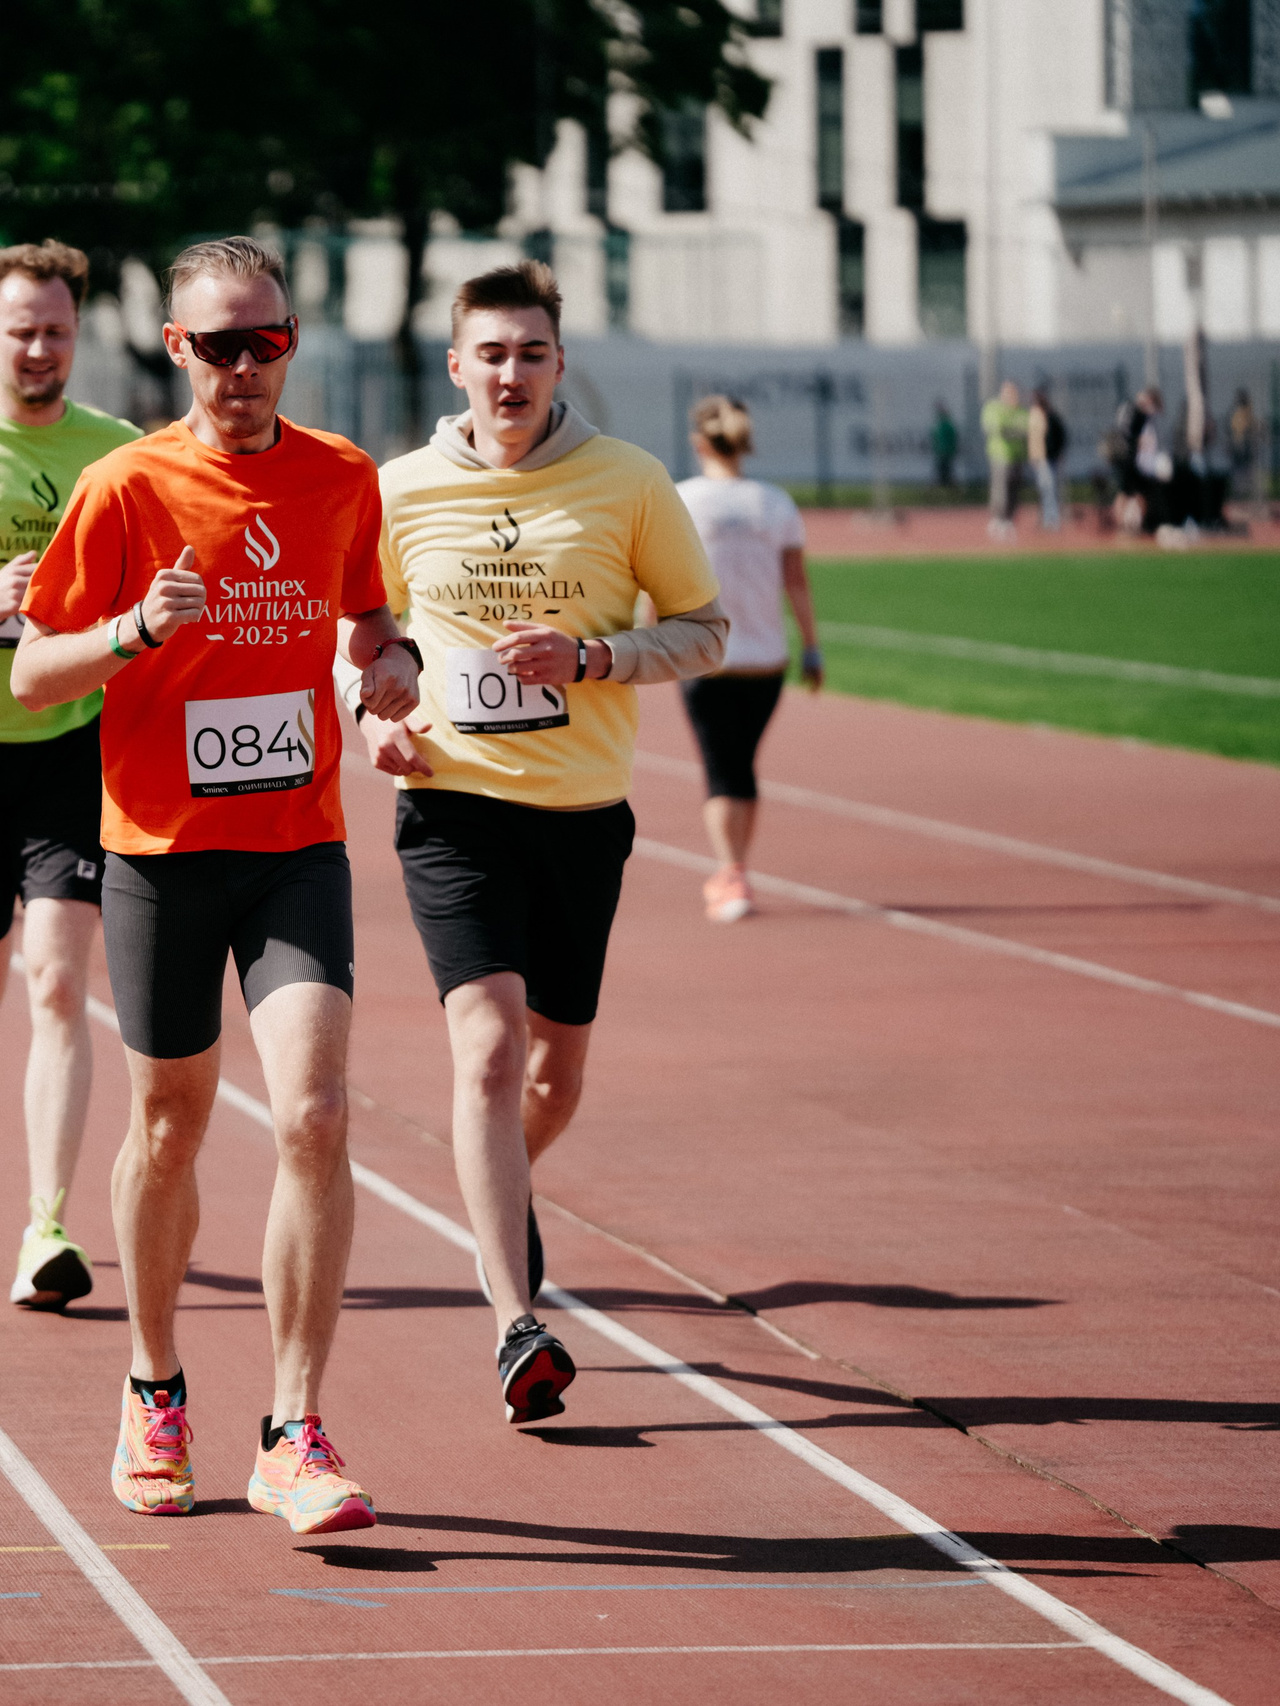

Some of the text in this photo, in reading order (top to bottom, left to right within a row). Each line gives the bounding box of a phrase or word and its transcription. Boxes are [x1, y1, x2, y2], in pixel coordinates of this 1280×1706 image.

[11, 514, 59, 533] Smin
[461, 557, 547, 578] Sminex
[220, 576, 306, 599] Sminex
[427, 580, 585, 601] ОЛИМПИАДА
[184, 599, 330, 624] ЛИМПИАДА
[479, 603, 533, 621] 2025
[232, 625, 288, 645] 2025
[460, 672, 523, 709] 101
[193, 720, 297, 769] 084
[202, 785, 229, 794] Sminex
